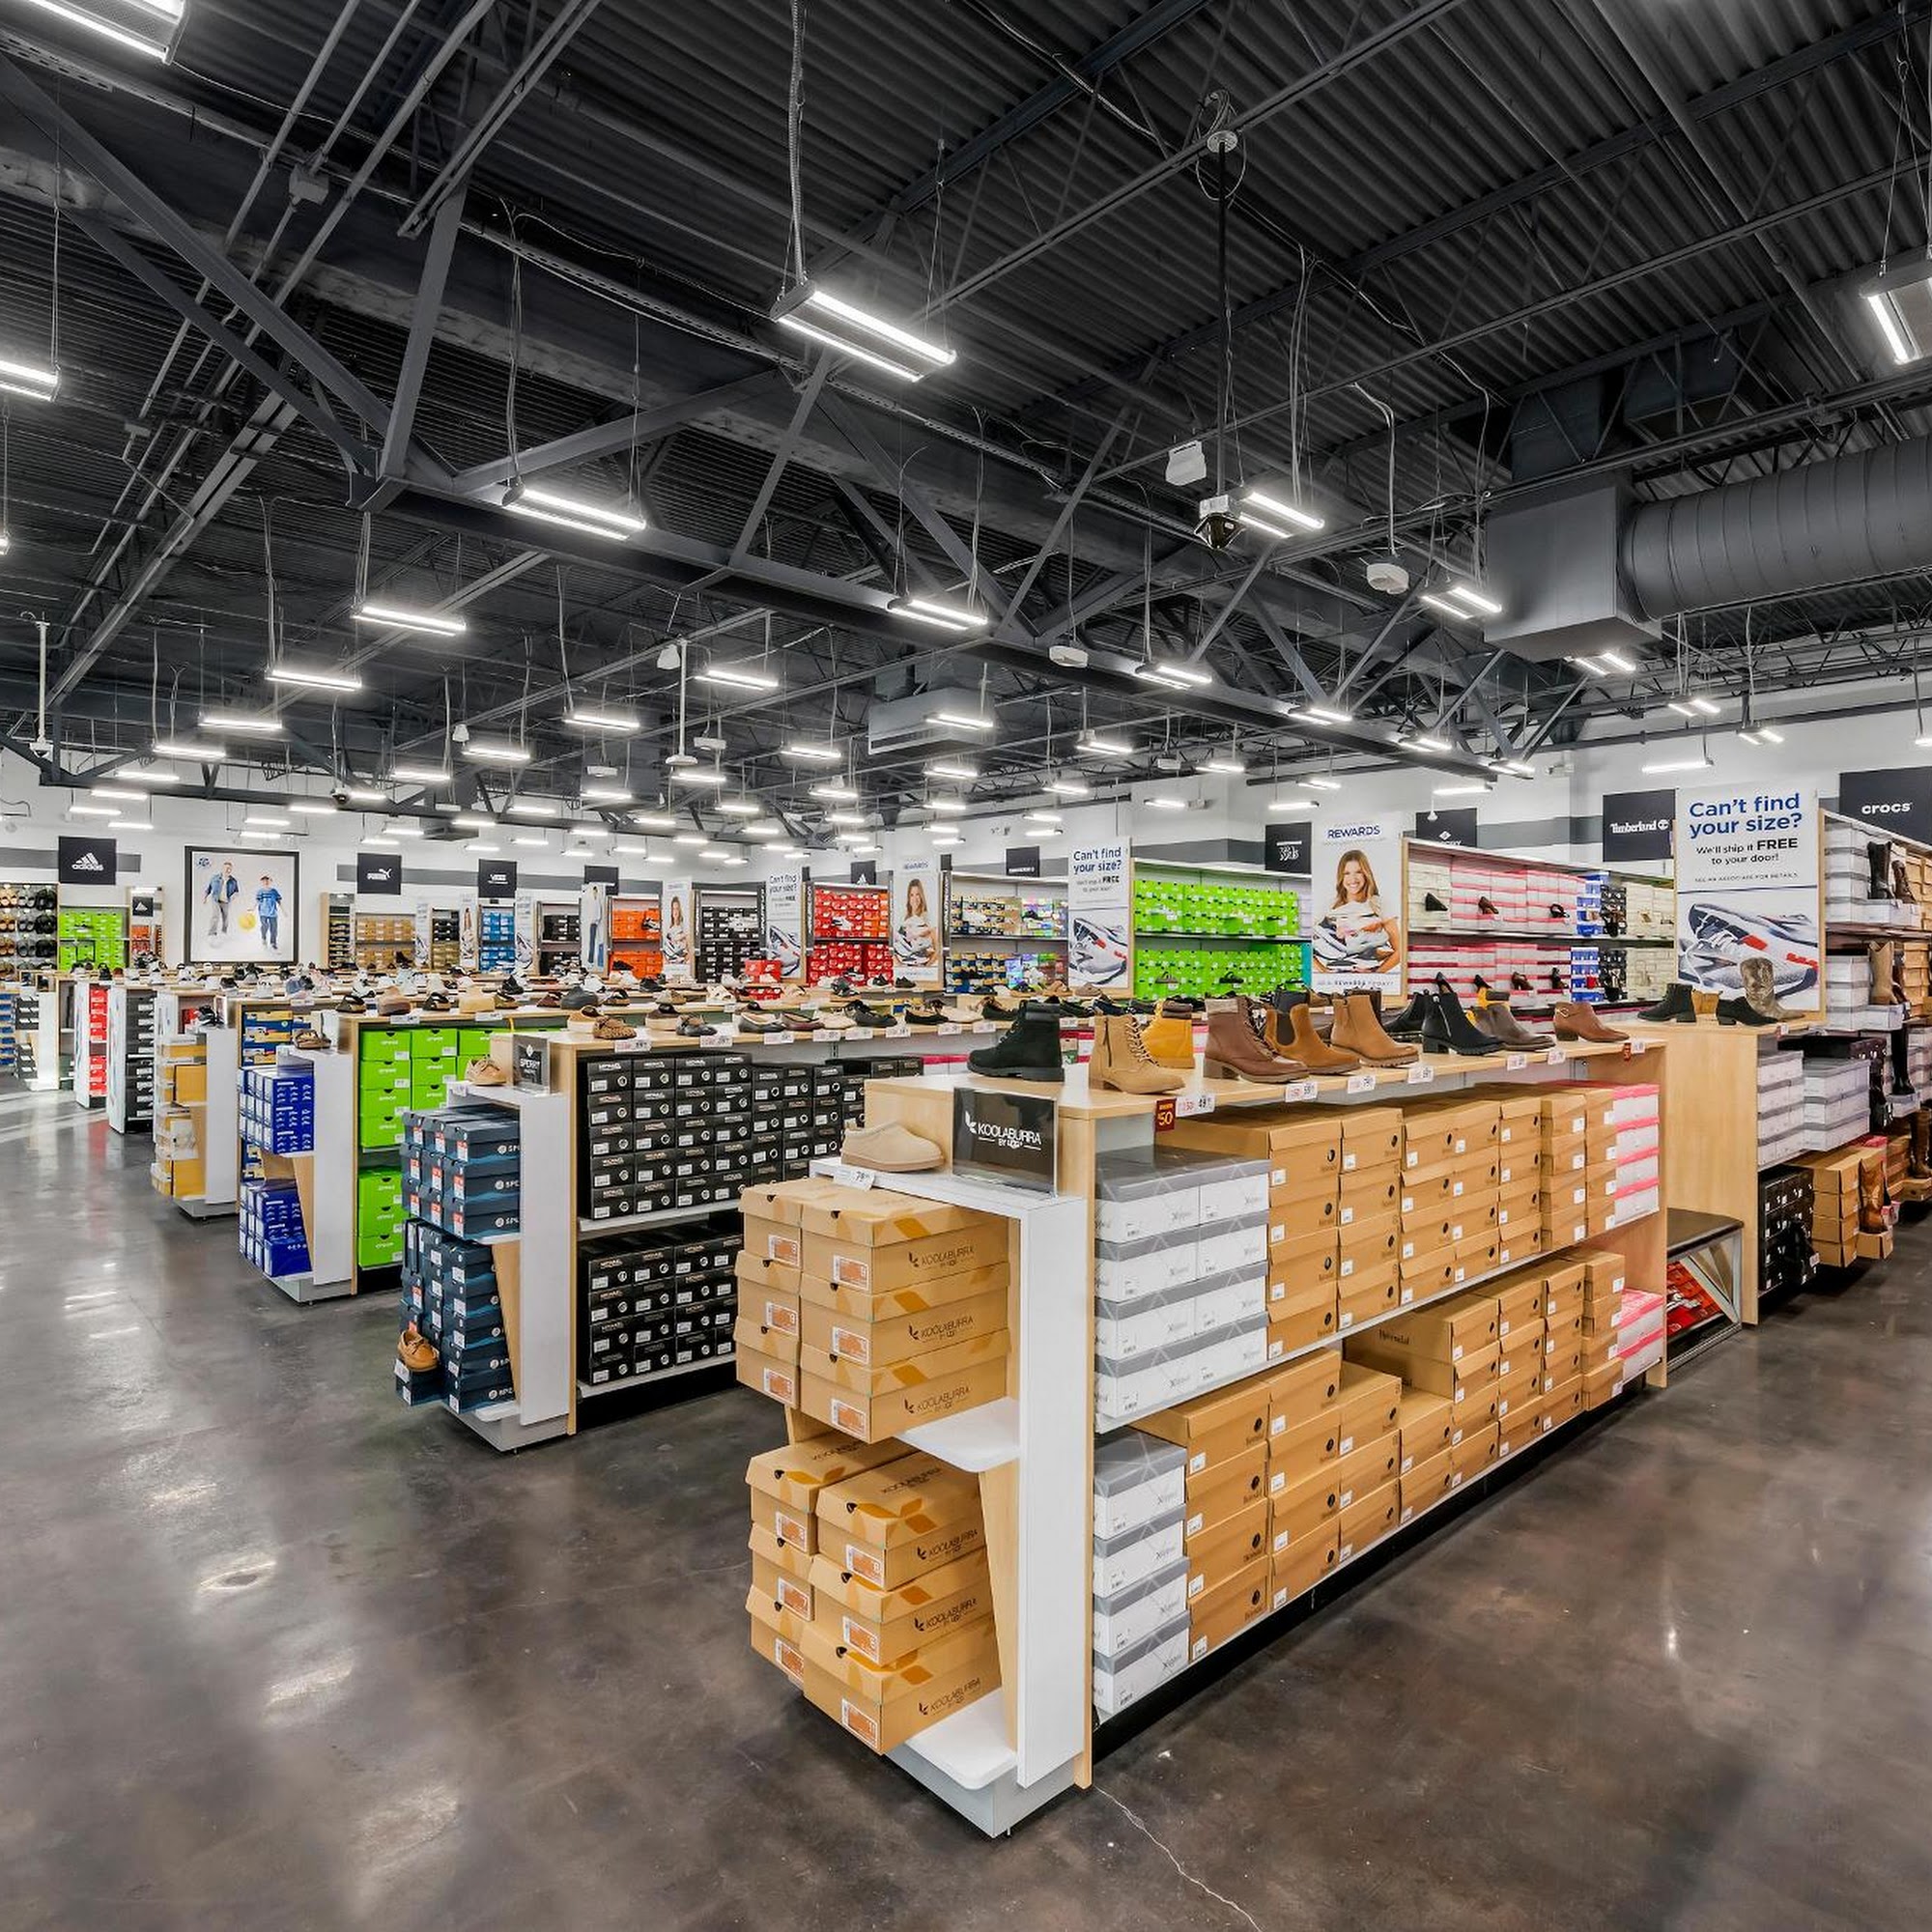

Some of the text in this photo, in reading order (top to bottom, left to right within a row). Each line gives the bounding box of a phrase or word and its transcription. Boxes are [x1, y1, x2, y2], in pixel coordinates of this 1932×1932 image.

[1689, 792, 1800, 818] Can't find
[1861, 803, 1912, 815] crocs
[1326, 825, 1381, 839] REWARDS
[1609, 819, 1658, 834] Timberland
[1689, 812, 1803, 839] your size?
[1723, 843, 1745, 854] ship
[1756, 838, 1799, 851] FREE
[1073, 846, 1122, 862] Can't find
[1724, 856, 1747, 866] your
[71, 863, 104, 871] adidas
[1073, 860, 1122, 875] your size?
[978, 1122, 1042, 1146] KOOLABURRA
